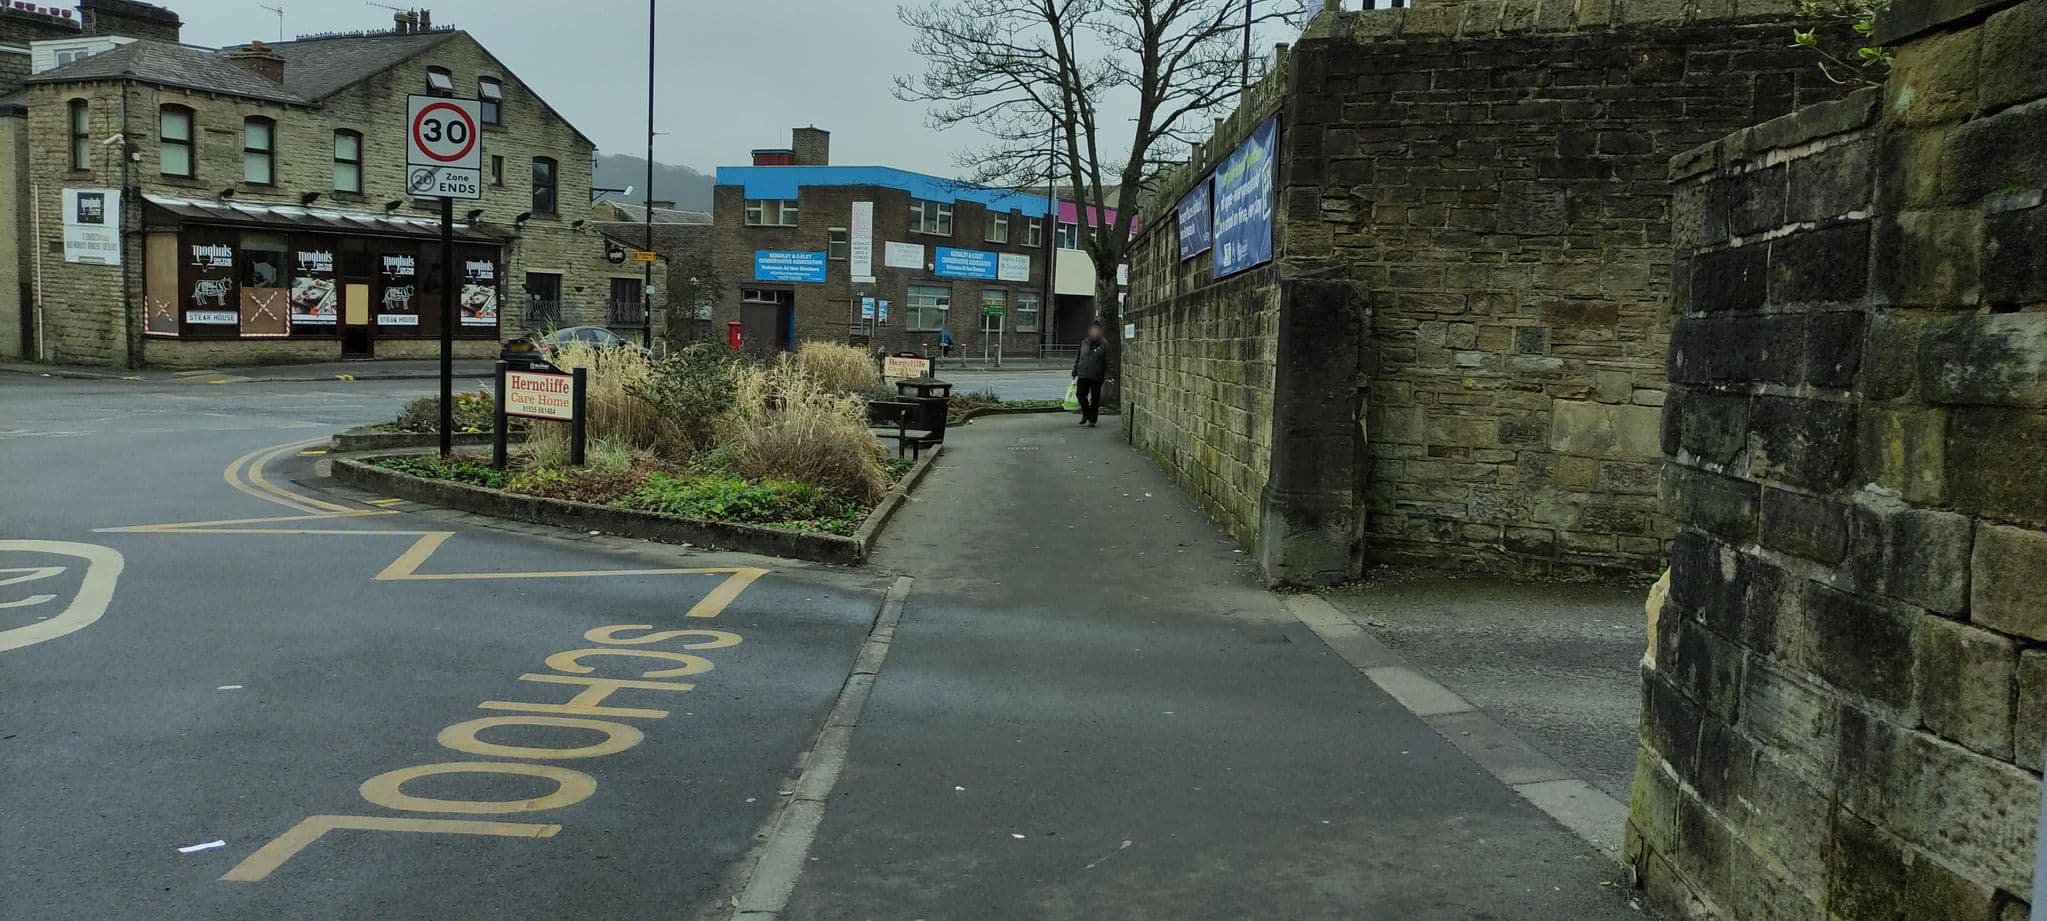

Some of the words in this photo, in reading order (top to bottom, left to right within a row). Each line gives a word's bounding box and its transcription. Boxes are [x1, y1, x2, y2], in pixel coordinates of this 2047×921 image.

[423, 118, 467, 144] 30
[414, 174, 432, 185] 20
[446, 172, 469, 182] Zone
[439, 182, 476, 194] ENDS
[189, 312, 211, 321] STEAK
[213, 313, 235, 321] HOUSE
[511, 375, 570, 394] Herncliffe
[511, 391, 535, 404] Care
[538, 394, 569, 408] Home
[220, 624, 743, 883] SCHOOL
